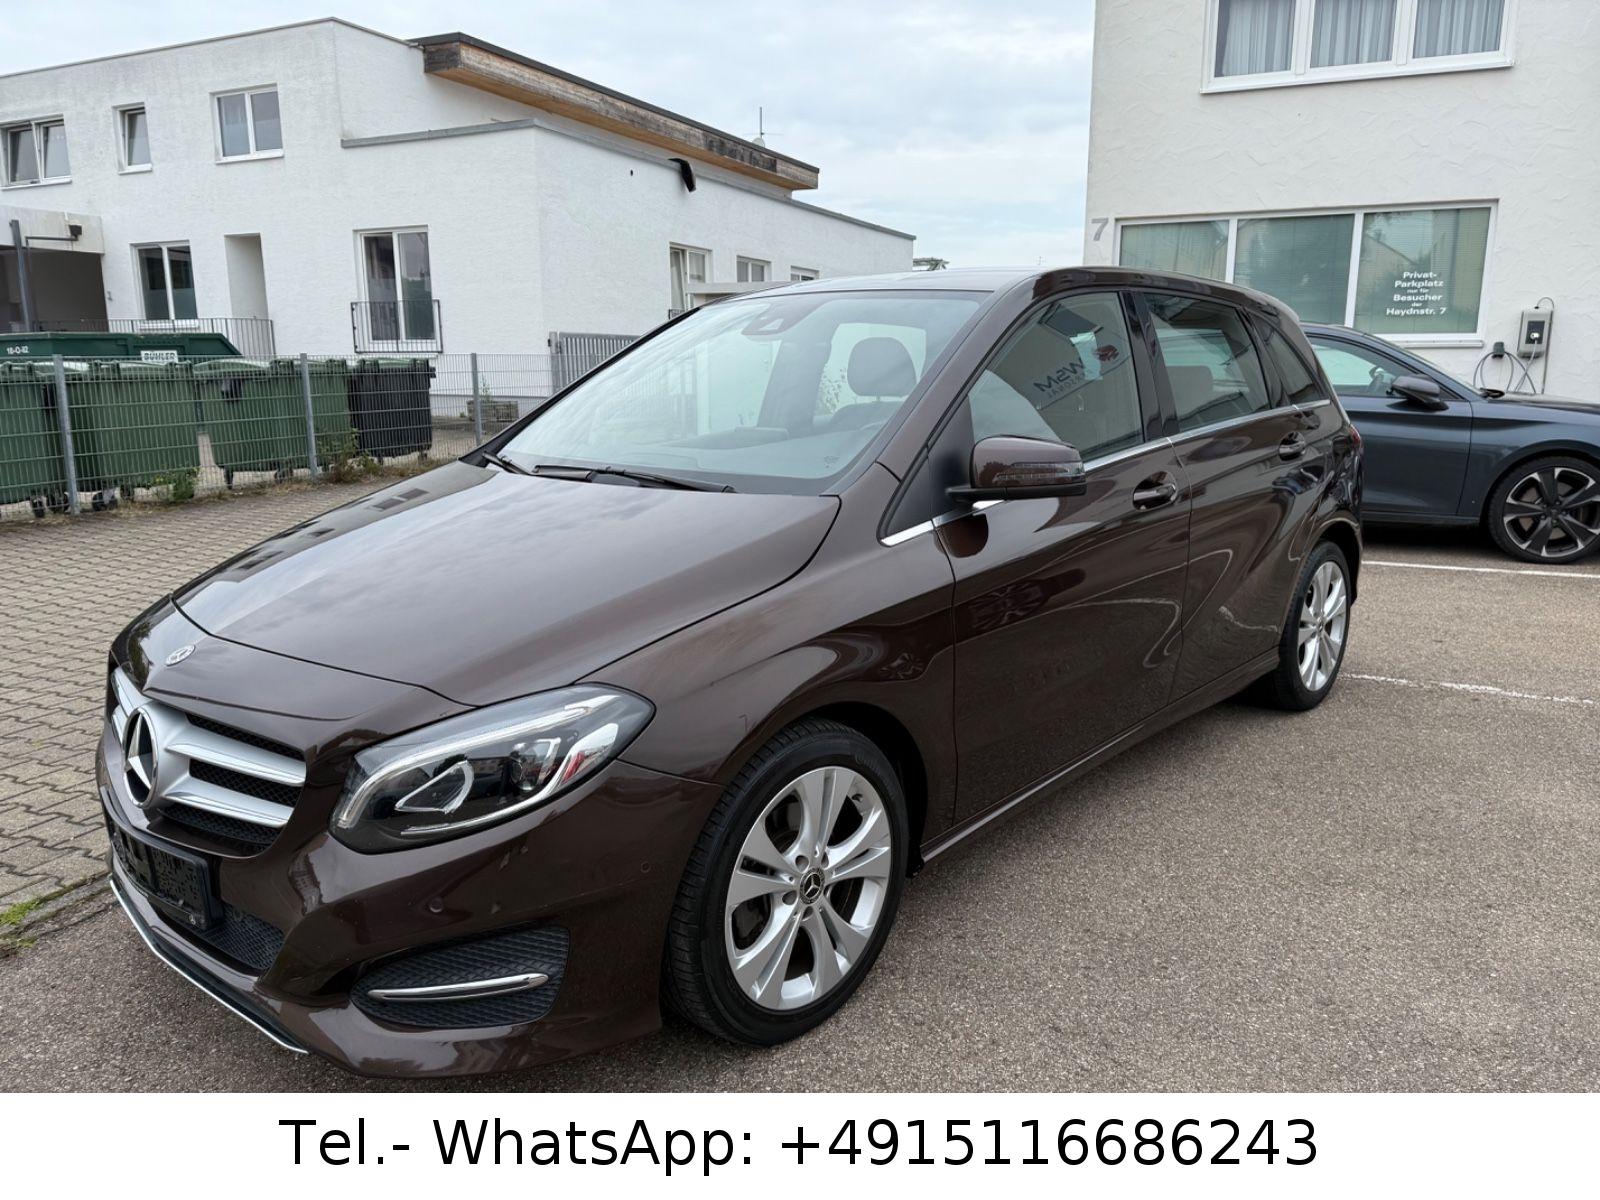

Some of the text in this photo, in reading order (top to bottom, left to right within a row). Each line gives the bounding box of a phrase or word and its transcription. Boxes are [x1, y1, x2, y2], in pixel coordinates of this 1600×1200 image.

[1091, 217, 1109, 241] 7
[1403, 271, 1437, 279] Privat-
[1394, 280, 1444, 288] Parkplatz
[1386, 307, 1447, 316] Haydnstr. 7
